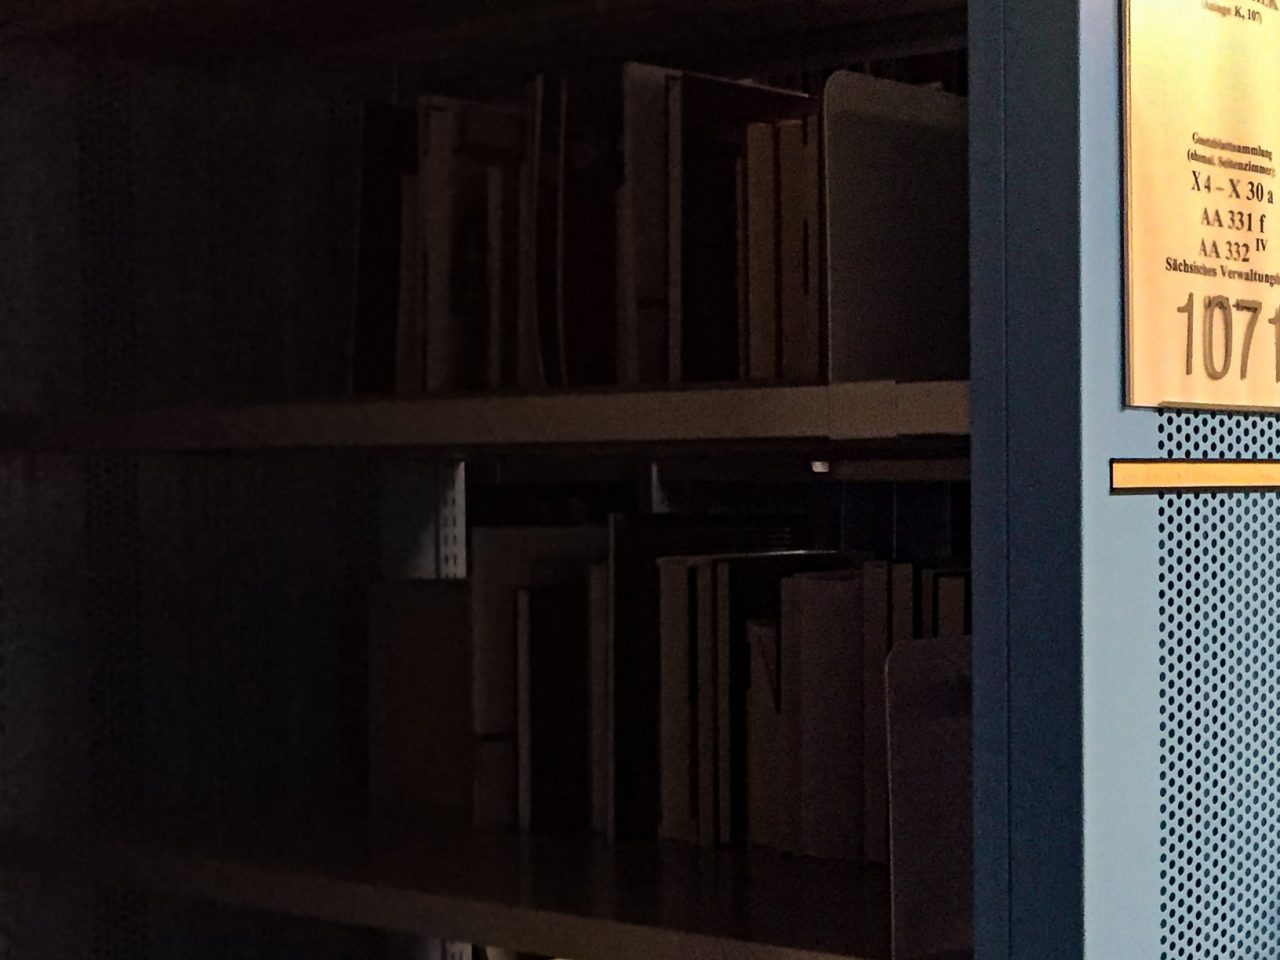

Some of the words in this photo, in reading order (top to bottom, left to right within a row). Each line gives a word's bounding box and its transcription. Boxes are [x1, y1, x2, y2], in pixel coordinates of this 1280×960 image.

[1191, 170, 1201, 192] X
[1203, 174, 1212, 194] 4
[1228, 178, 1241, 199] X
[1246, 180, 1264, 202] 30
[1267, 189, 1274, 205] a
[1201, 207, 1224, 228] AA
[1227, 209, 1253, 233] 331
[1259, 213, 1267, 233] f
[1199, 237, 1221, 259] AA
[1225, 240, 1251, 263] 332
[1255, 237, 1269, 252] IV
[1165, 256, 1217, 278] Sächsisches
